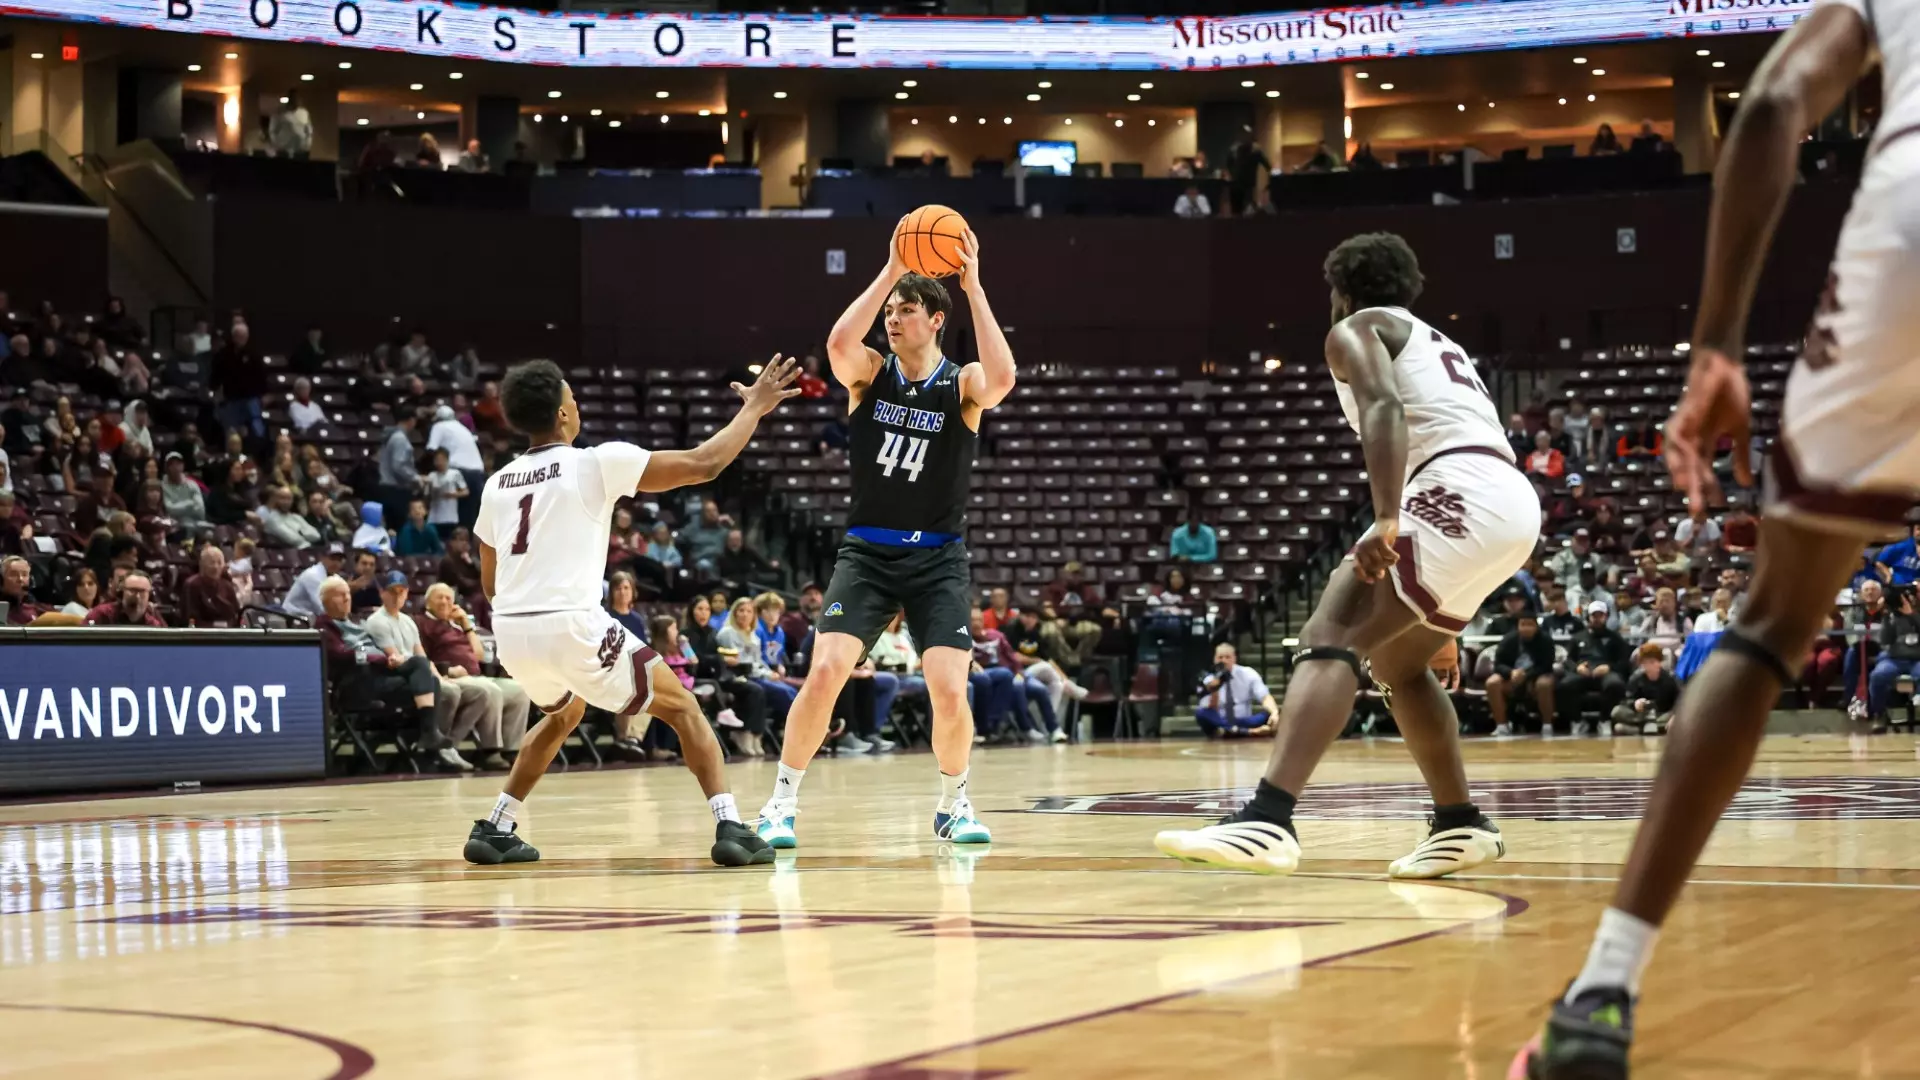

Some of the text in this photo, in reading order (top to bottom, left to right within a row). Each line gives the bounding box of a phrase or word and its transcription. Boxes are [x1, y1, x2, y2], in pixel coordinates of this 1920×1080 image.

[1172, 11, 1404, 49] Missouri State
[1187, 43, 1395, 67] BOOKSTORE
[873, 399, 945, 433] BLUE HENS
[498, 462, 561, 489] WILLIAMS JR.
[876, 431, 930, 482] 44
[510, 493, 535, 555] 1
[0, 684, 287, 740] VANDIVORT
